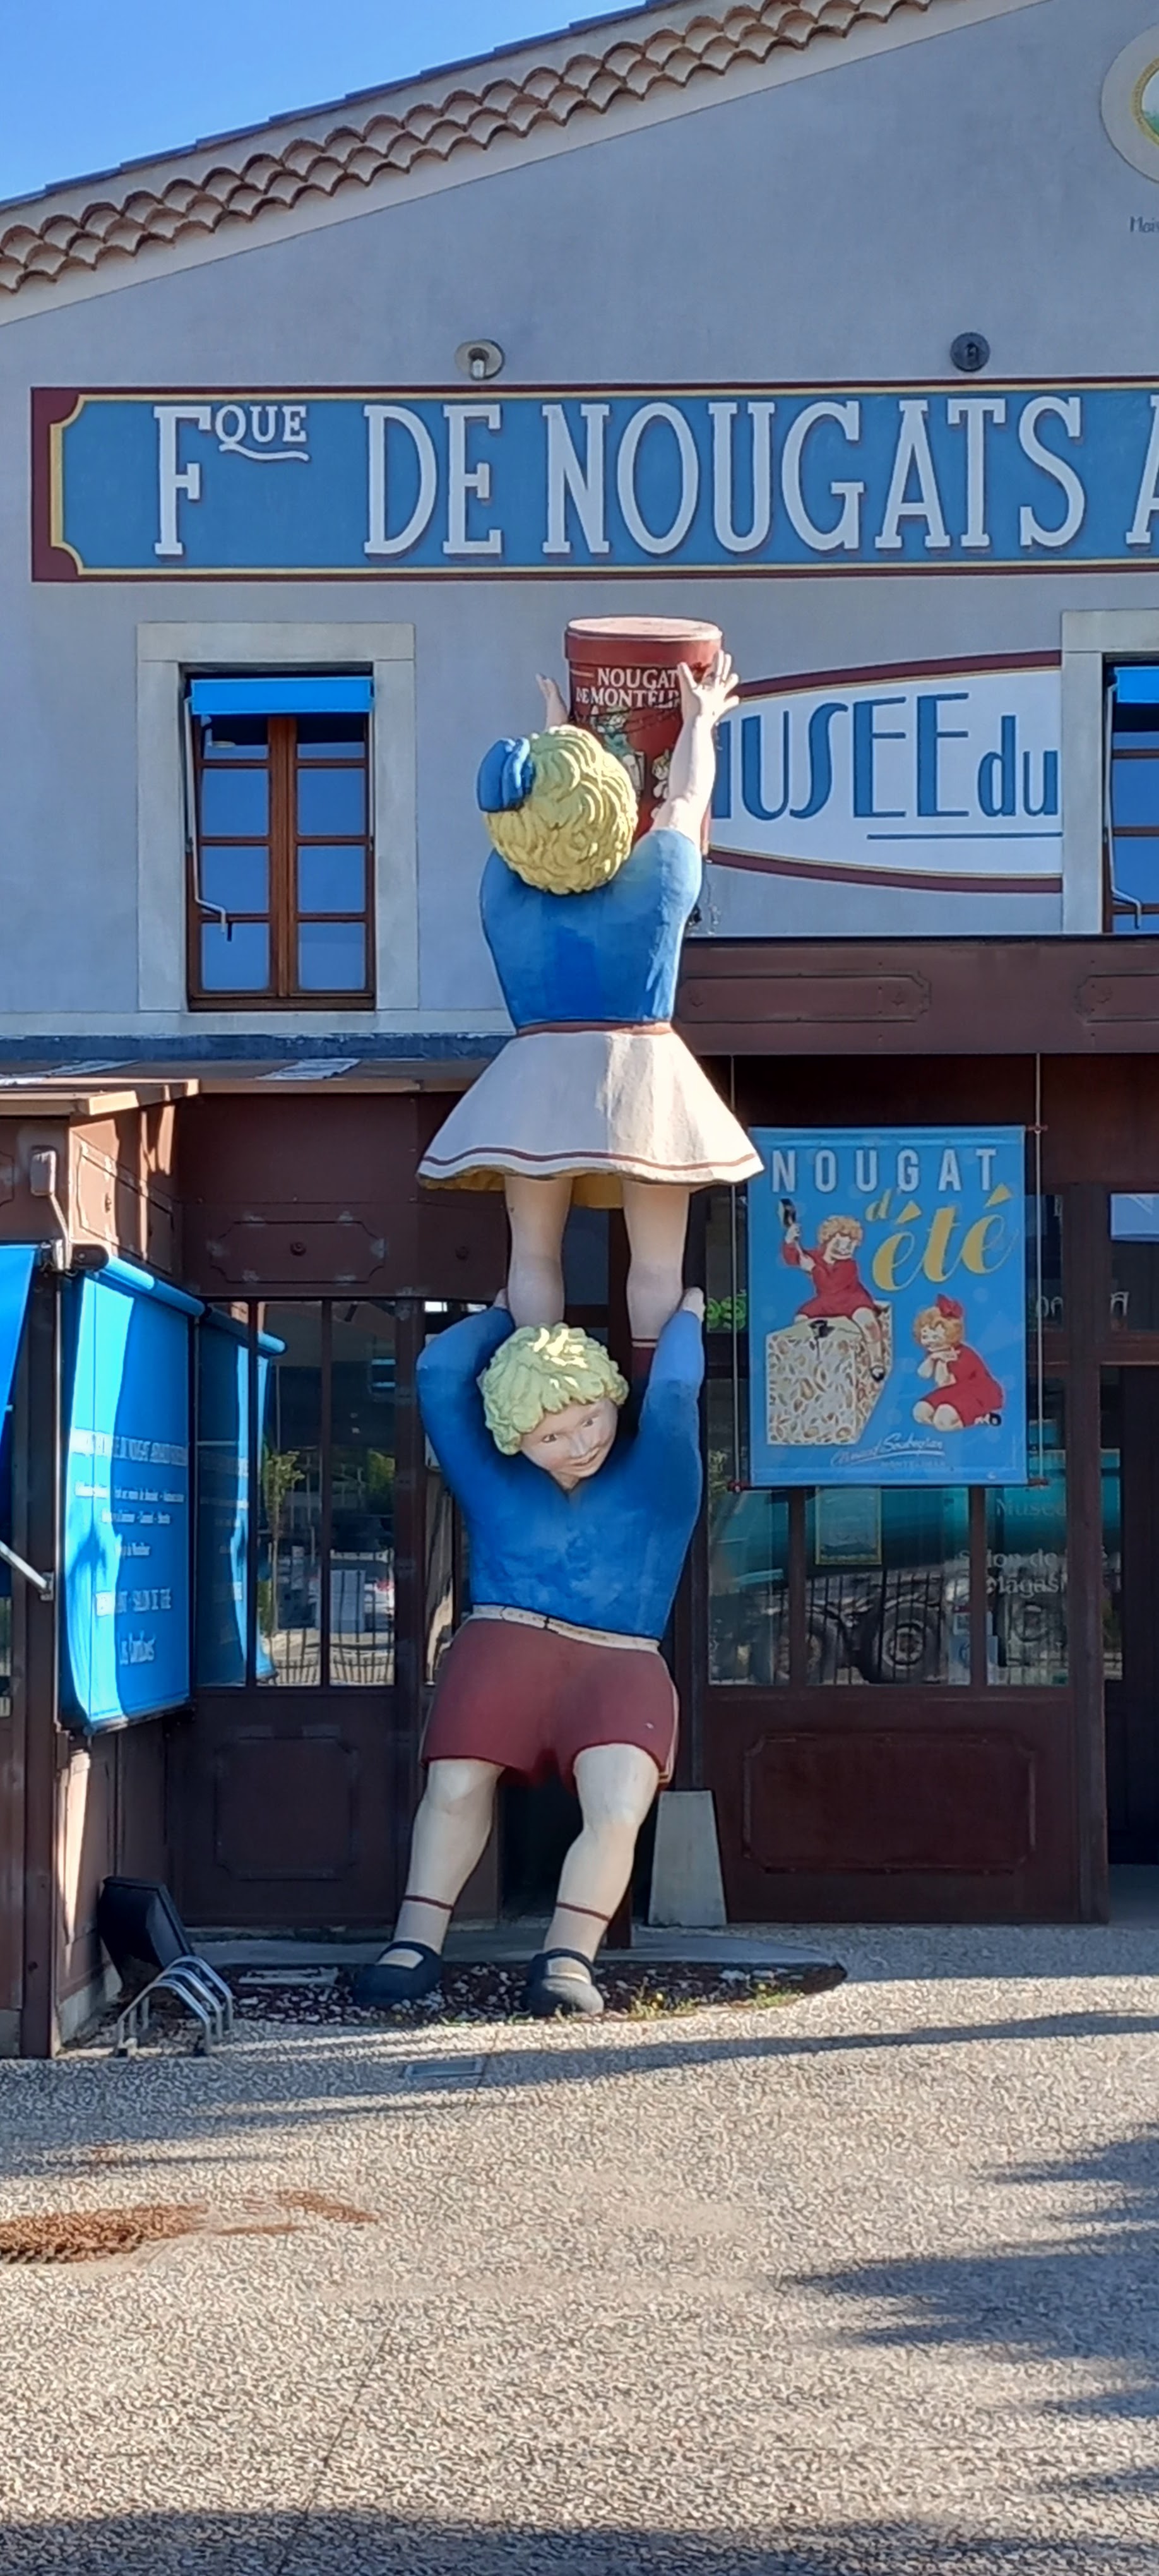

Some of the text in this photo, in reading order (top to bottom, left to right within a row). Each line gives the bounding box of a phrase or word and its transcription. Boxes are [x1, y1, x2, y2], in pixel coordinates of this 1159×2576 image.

[364, 404, 502, 556] DE
[542, 397, 1085, 555] NOUGATS
[597, 667, 678, 689] NOUGAT
[978, 715, 1058, 817] du
[772, 1148, 997, 1193] NOUGAT
